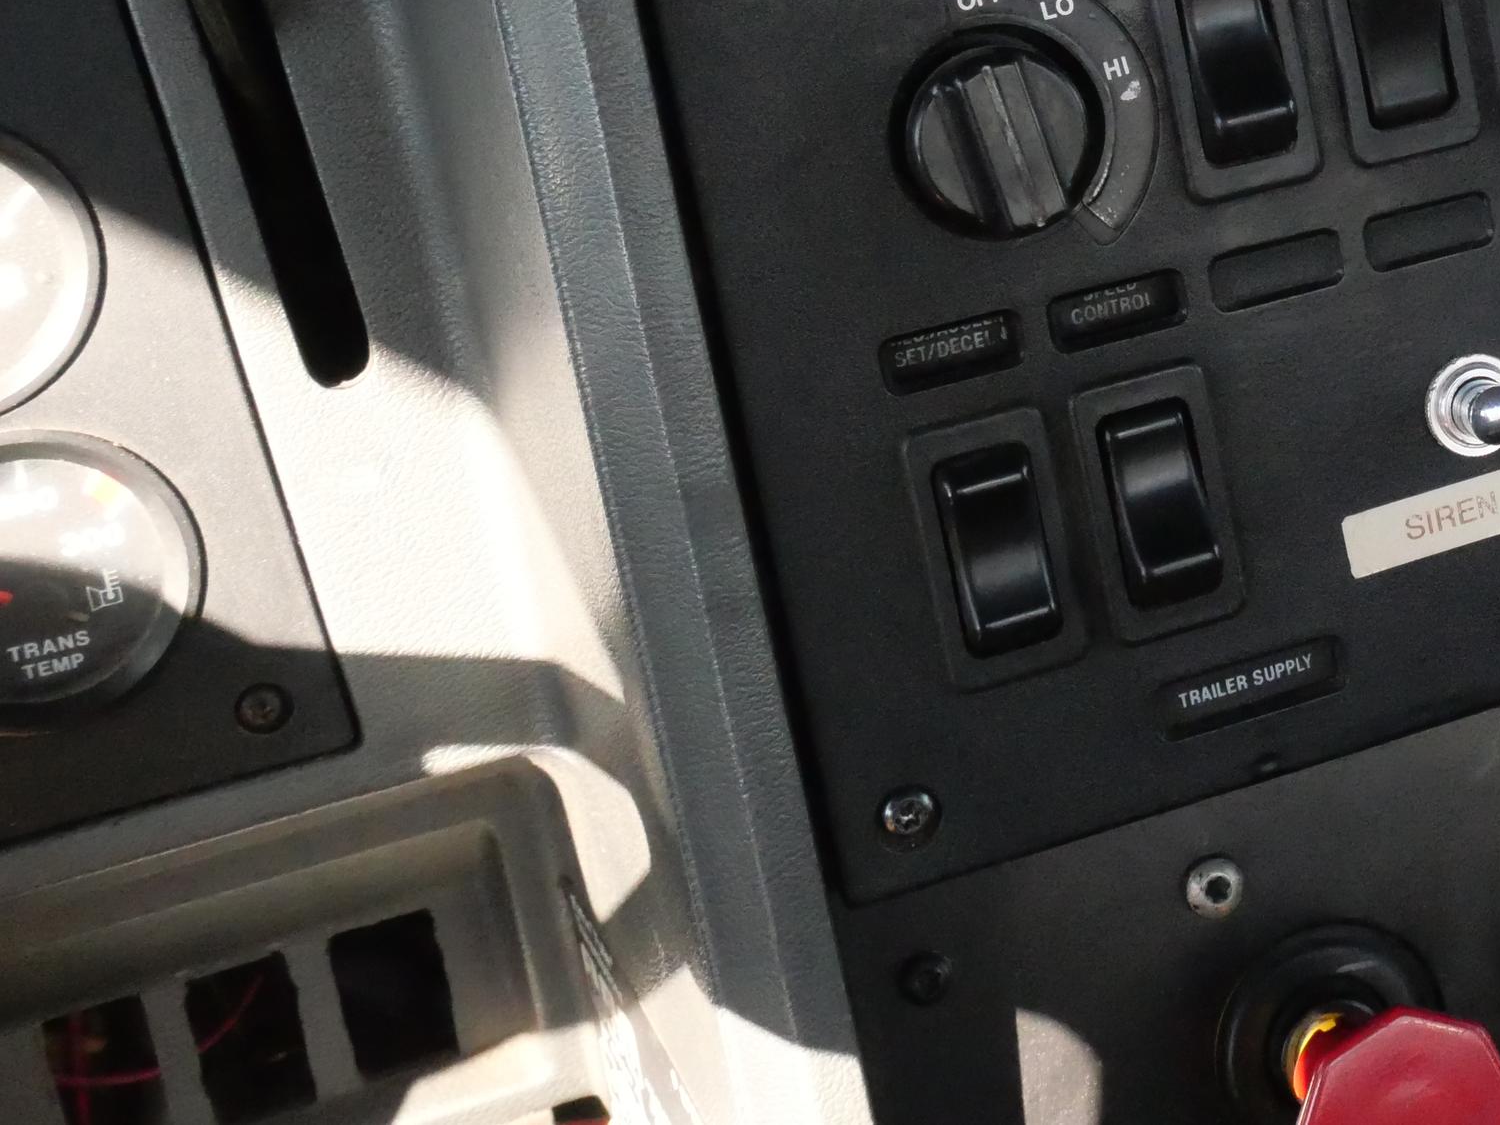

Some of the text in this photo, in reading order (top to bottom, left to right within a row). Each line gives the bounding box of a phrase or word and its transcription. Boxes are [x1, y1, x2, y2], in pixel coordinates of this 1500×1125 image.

[1102, 55, 1130, 81] HI
[1405, 491, 1498, 541] SIREN
[6, 630, 91, 663] TRANS
[21, 652, 84, 680] TEMP
[1178, 653, 1313, 708] TRAILER SUPPLY
